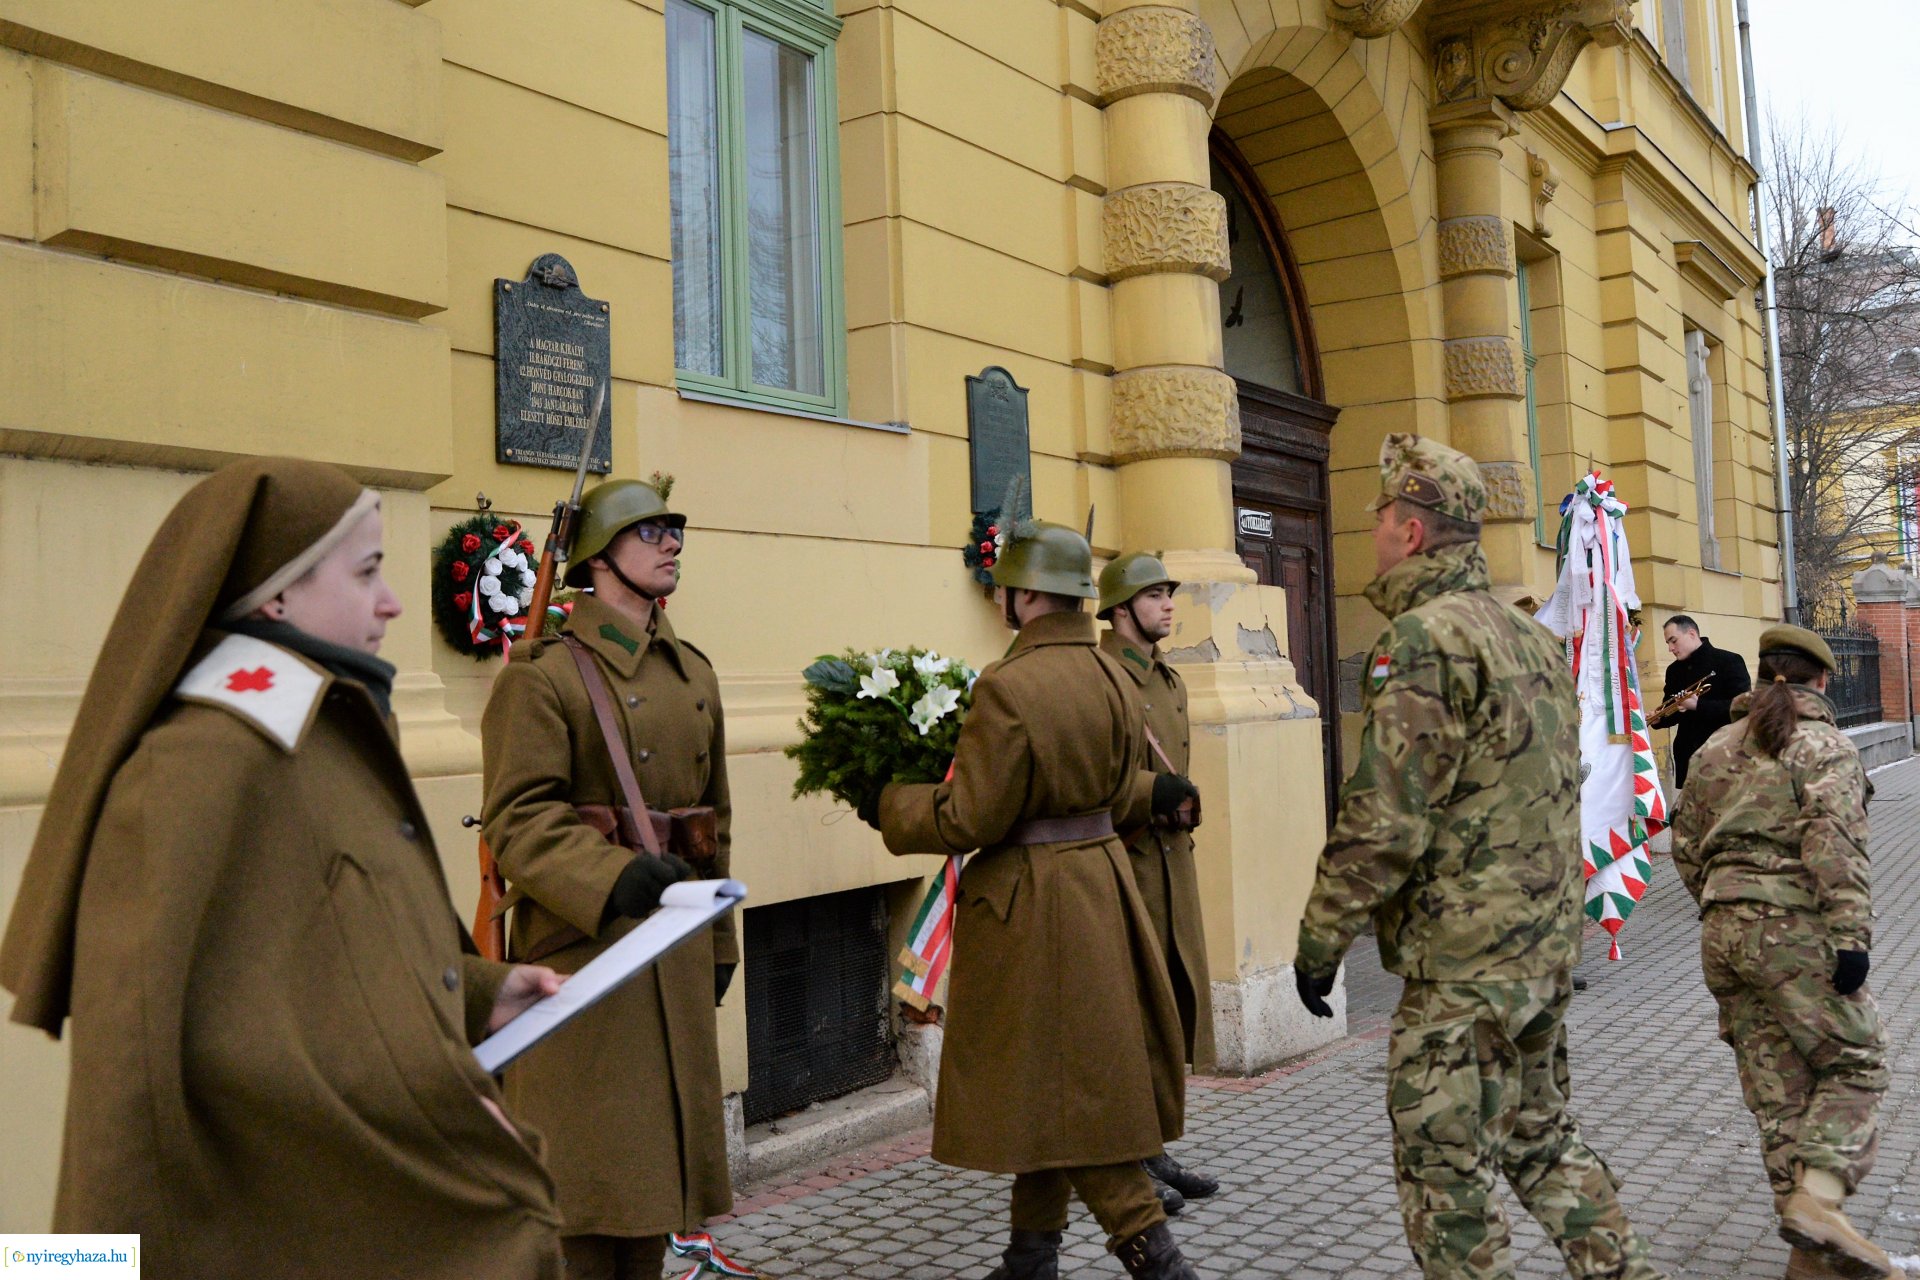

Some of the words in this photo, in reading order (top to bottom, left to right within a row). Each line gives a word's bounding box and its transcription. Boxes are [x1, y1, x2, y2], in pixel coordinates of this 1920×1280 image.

[535, 338, 560, 352] MAGYAR
[560, 341, 584, 358] KIRÁLYI
[562, 357, 586, 371] FERENC
[552, 370, 595, 387] GYALOGEZRED
[548, 384, 584, 400] HARCOKBAN
[544, 398, 584, 414] JANUÁRJÁBAN
[520, 409, 545, 423] ELESETT
